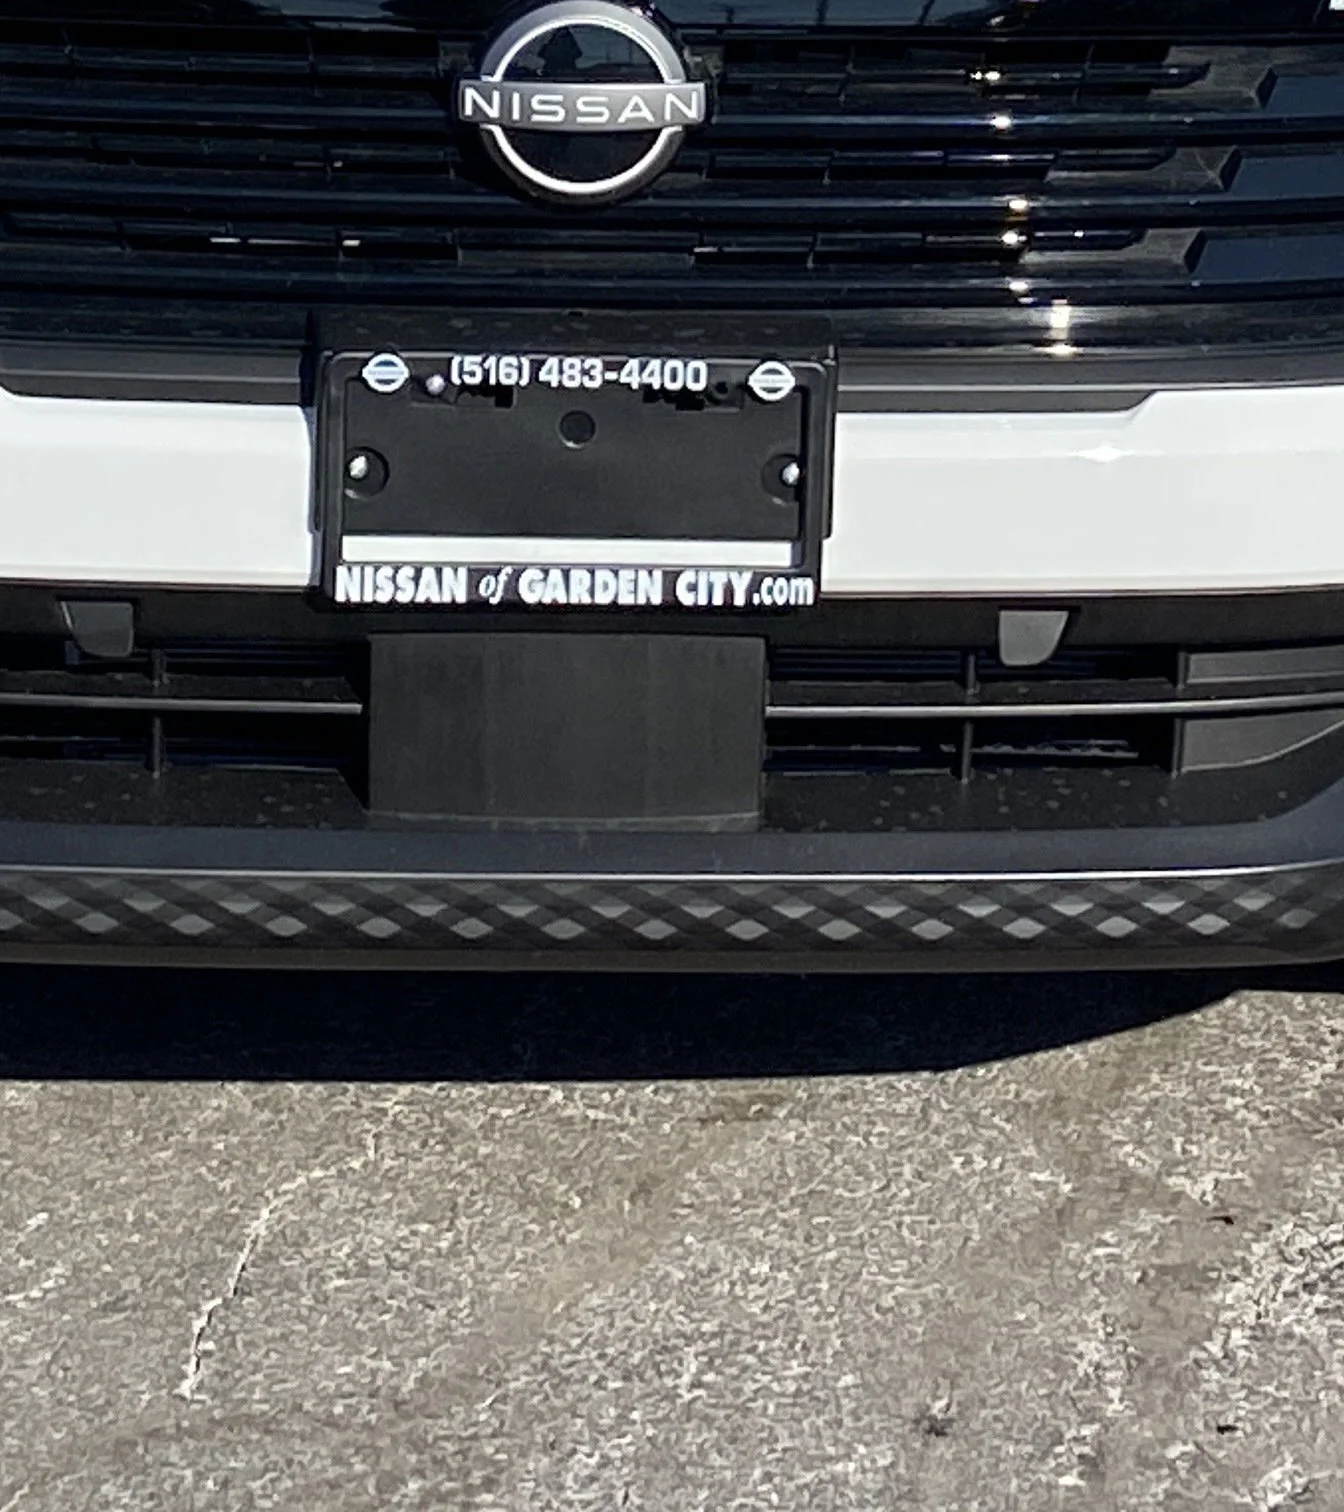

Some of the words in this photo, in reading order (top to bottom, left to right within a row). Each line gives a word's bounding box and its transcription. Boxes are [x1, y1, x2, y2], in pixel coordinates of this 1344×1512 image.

[463, 87, 698, 124] NISSAN
[450, 355, 530, 386] (516)
[539, 357, 708, 391] 483-4400
[334, 565, 468, 603] NISSAN
[479, 566, 514, 605] of
[518, 568, 663, 605] GARDEN
[675, 570, 814, 606] CITY.com
